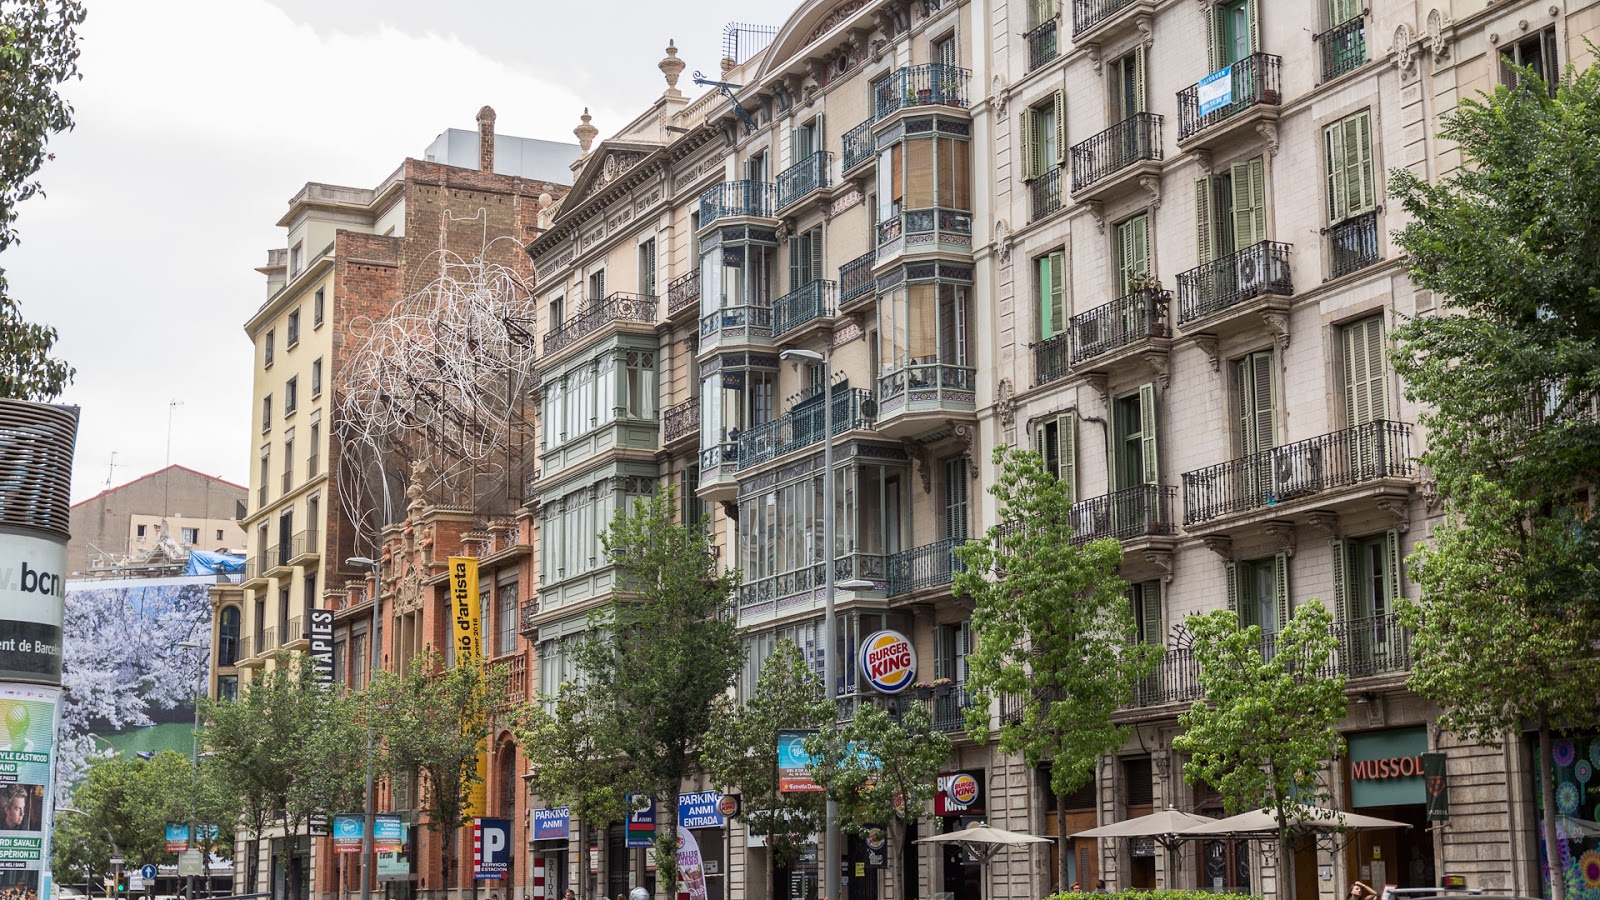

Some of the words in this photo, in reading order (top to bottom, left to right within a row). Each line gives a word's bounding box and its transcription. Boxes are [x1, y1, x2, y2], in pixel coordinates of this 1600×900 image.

[18, 639, 32, 652] de
[869, 642, 909, 665] BURGER
[871, 652, 911, 680] KING
[15, 753, 48, 763] EASTWOOD
[1351, 756, 1425, 781] MUSSOL
[954, 781, 975, 789] BURGER
[955, 787, 976, 797] KING
[679, 793, 721, 806] PARKING
[535, 808, 569, 820] PARKING
[688, 805, 714, 816] ANMI
[542, 820, 563, 829] ANMI
[683, 816, 719, 827] ENTRADA
[13, 839, 36, 847] SAVALL
[484, 827, 505, 863] P
